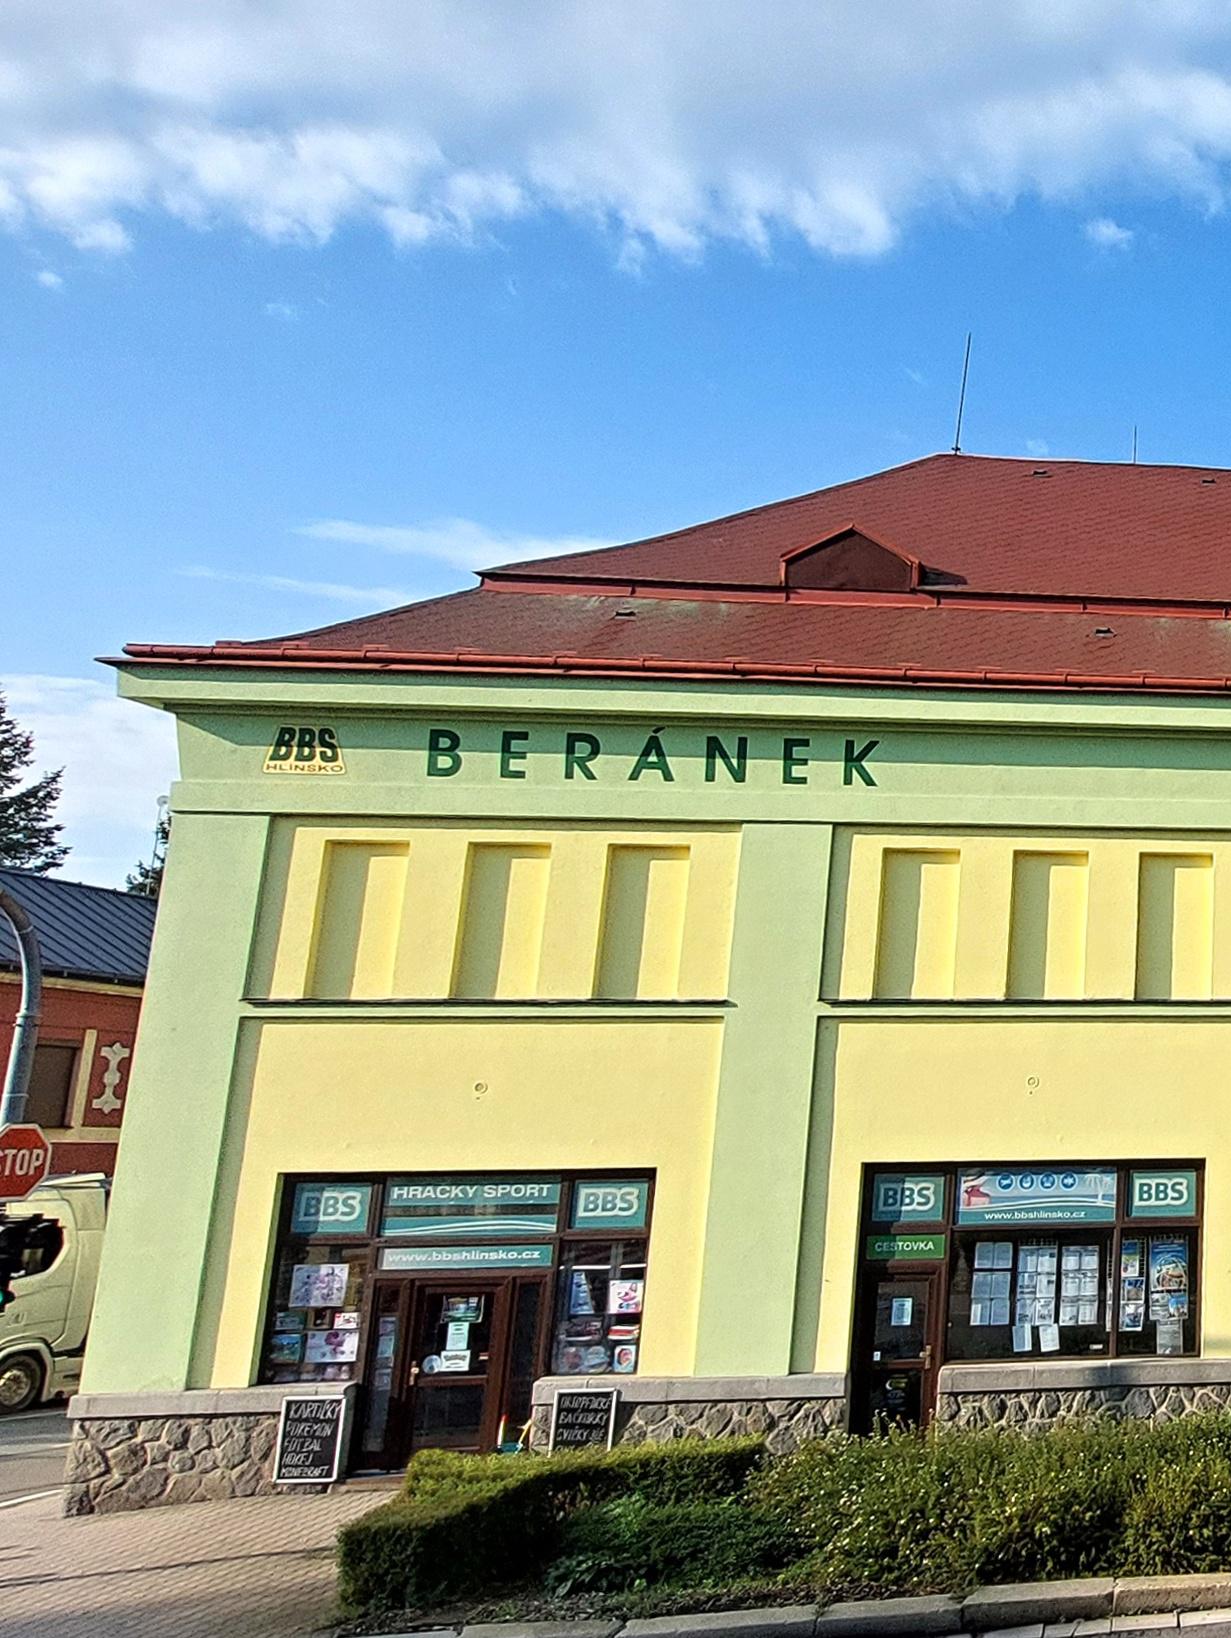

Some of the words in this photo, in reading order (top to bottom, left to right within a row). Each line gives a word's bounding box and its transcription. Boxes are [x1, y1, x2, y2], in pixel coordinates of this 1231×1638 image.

[269, 726, 339, 763] BBS
[427, 726, 880, 787] BERÁNEK
[265, 763, 343, 773] HLINSKO
[483, 1183, 552, 1199] SPORT
[583, 1190, 636, 1213] BBS
[883, 1186, 932, 1208] BBS
[1138, 1181, 1184, 1202] BBS
[302, 1194, 359, 1218] BBS
[984, 1210, 1086, 1221] www.bbshlinsko.cz
[388, 1249, 541, 1262] www.bbshlinsko.cz
[874, 1240, 935, 1252] CESTOVKA
